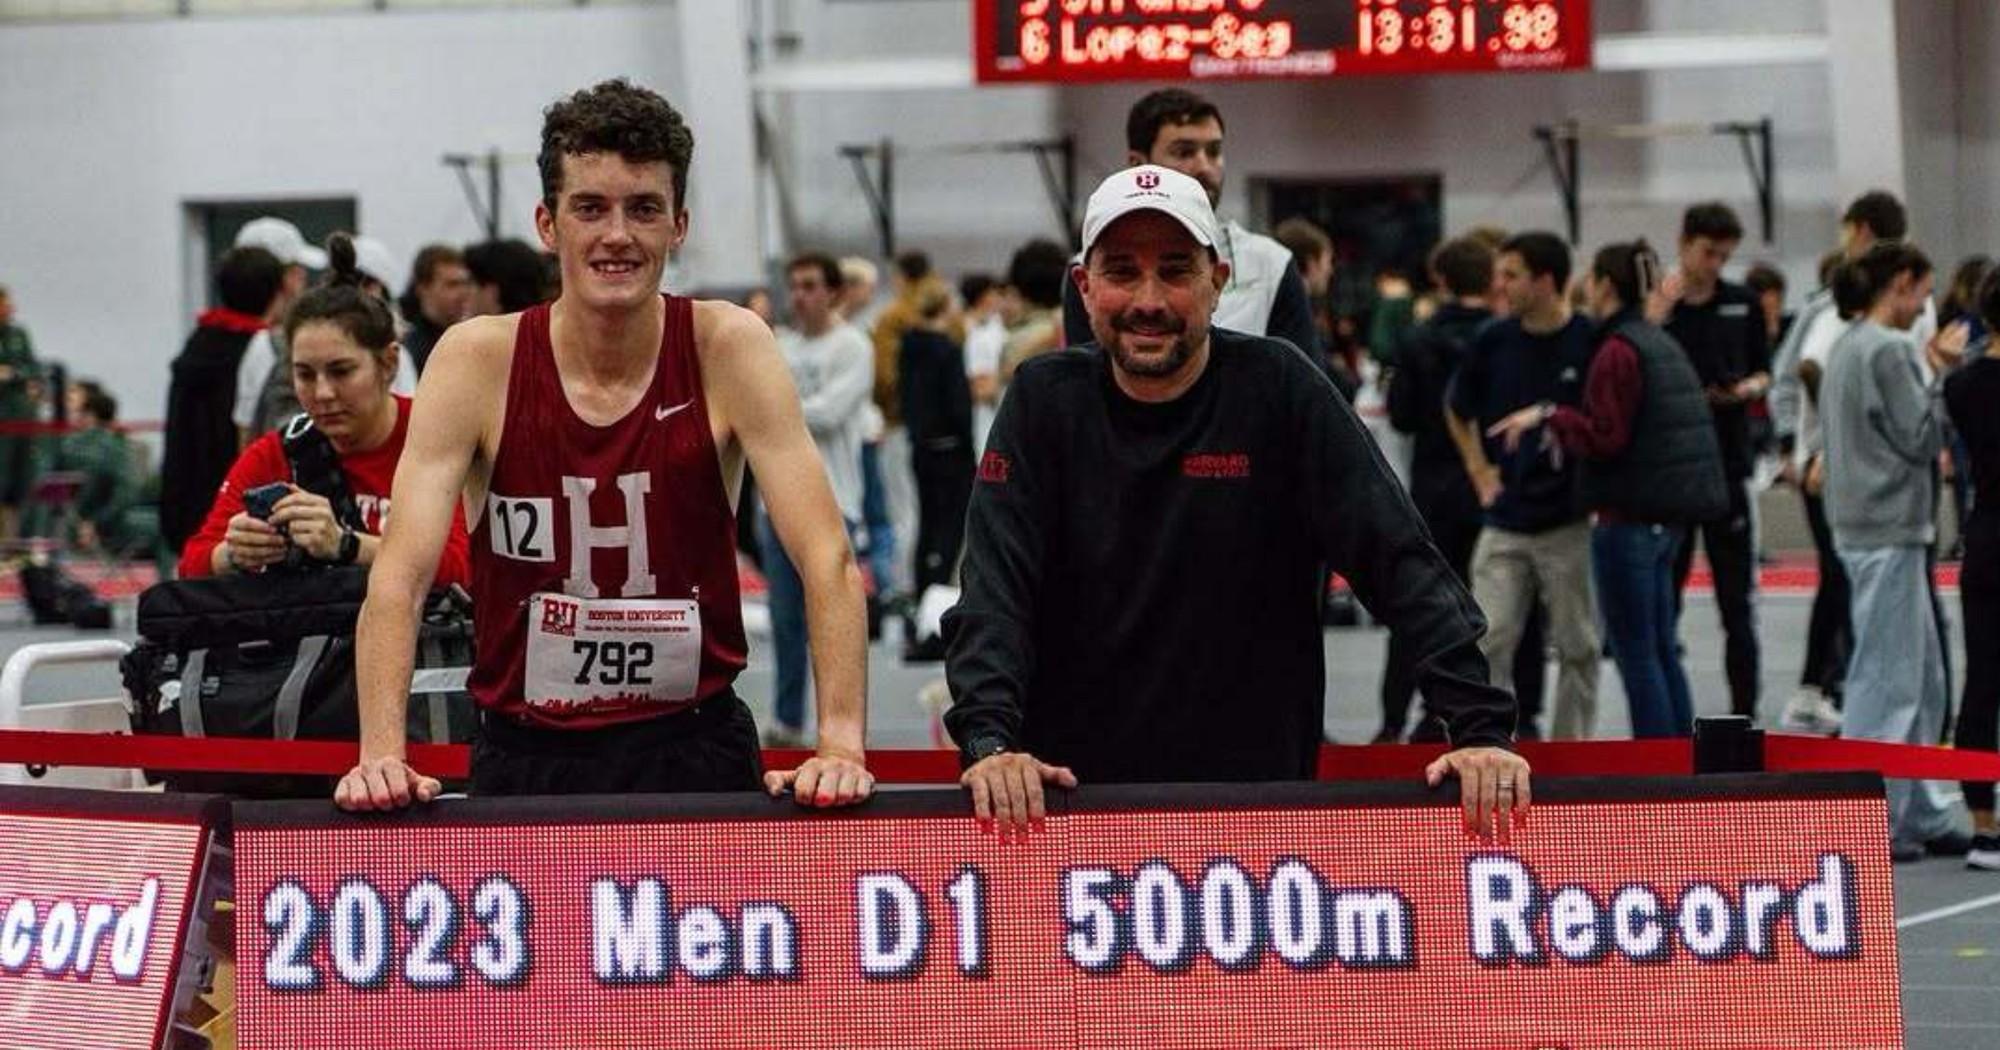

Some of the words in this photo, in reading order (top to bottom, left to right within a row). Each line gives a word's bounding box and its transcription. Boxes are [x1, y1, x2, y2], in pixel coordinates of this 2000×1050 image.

[1020, 17, 1050, 64] 6
[495, 500, 542, 558] 12
[561, 471, 657, 598] H
[573, 640, 654, 685] 792
[263, 876, 530, 990] 2023
[592, 875, 799, 984] Men
[856, 864, 989, 979] D1
[1064, 860, 1415, 973] 5000m
[1465, 853, 1860, 966] Record
